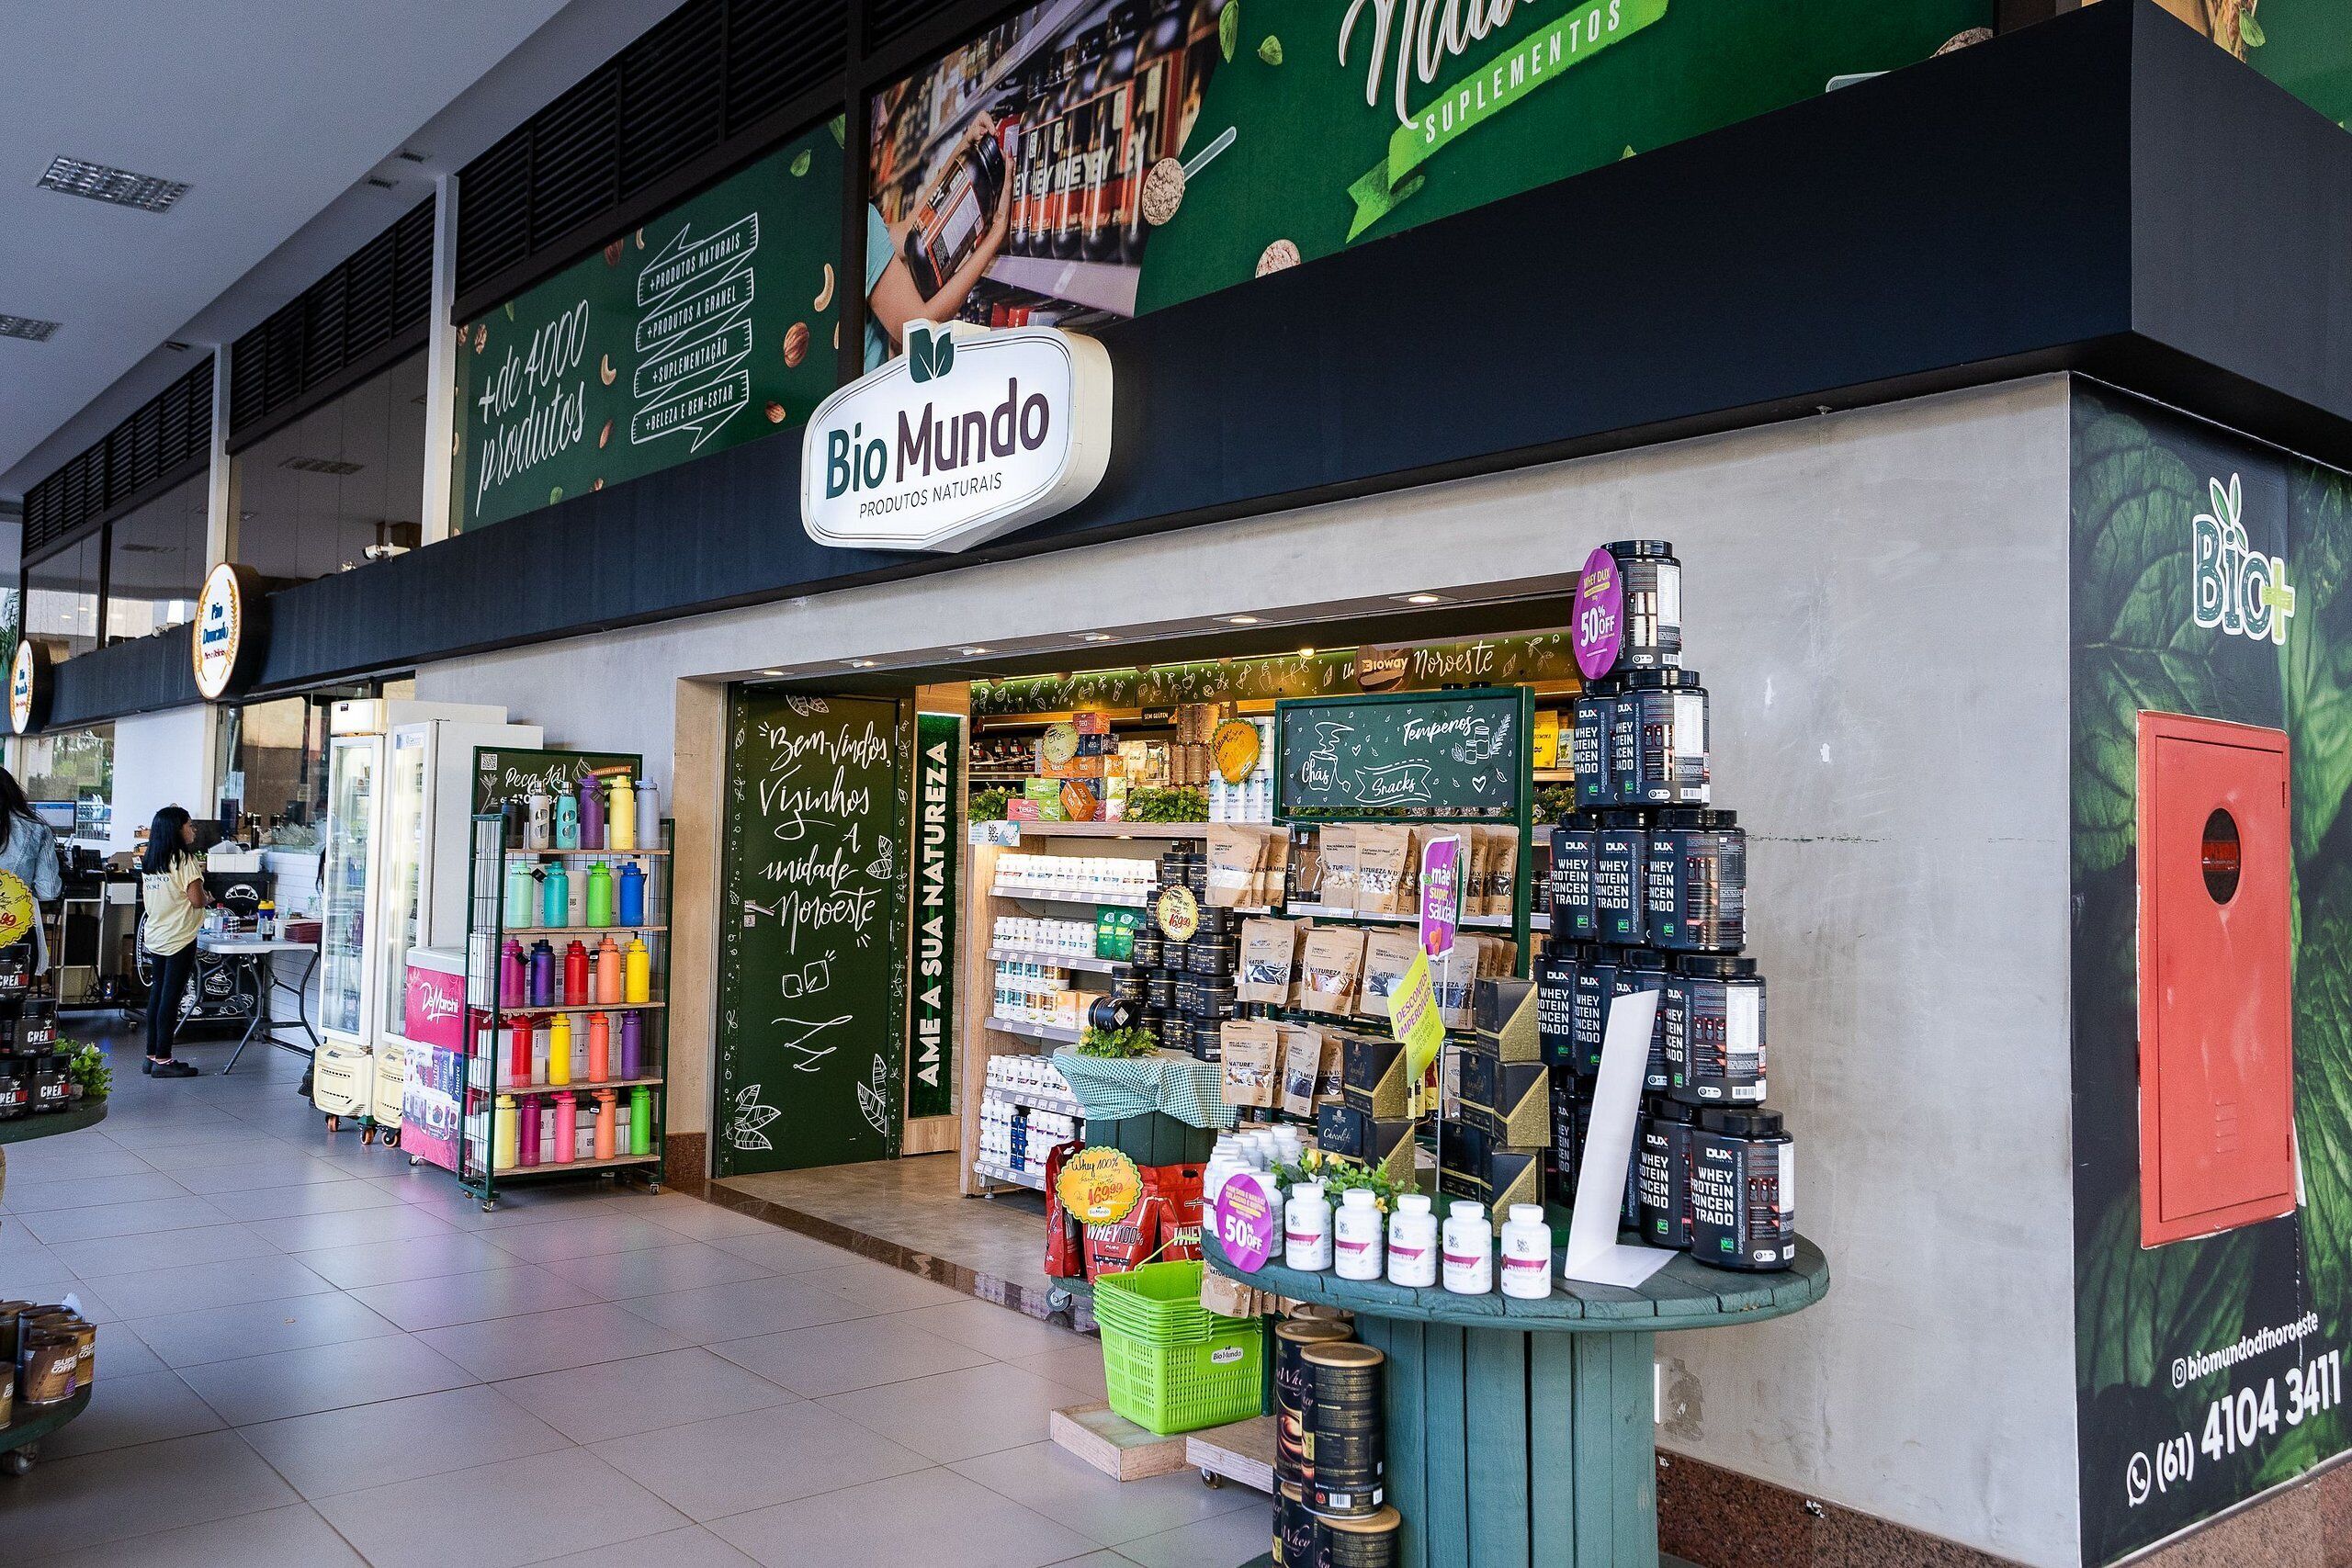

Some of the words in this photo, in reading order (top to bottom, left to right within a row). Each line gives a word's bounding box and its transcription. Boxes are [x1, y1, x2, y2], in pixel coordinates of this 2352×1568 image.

[1425, 0, 1621, 143] SUPLEMENTOS
[698, 231, 741, 273] NATURAIS
[695, 304, 703, 319] A
[705, 287, 737, 316] GRANEL
[525, 299, 589, 395] 4000
[680, 406, 686, 420] E
[687, 386, 734, 418] BEM-ESTAR
[477, 380, 587, 516] produtos
[826, 422, 888, 501] Bio
[896, 377, 1050, 483] Mundo
[860, 491, 928, 519] PRODUTOS
[933, 472, 1002, 503] NATURAIS
[1599, 615, 1615, 635] OFF
[1414, 640, 1495, 680] Noroeste
[1578, 709, 1598, 718] DUX
[1617, 704, 1633, 712] DUX
[1403, 715, 1486, 746] Temperos
[1372, 770, 1416, 797] Snacks
[760, 764, 869, 840] Vizinhos
[922, 741, 948, 906] NATUREZA
[842, 822, 862, 853] A
[1566, 841, 1588, 851] DUX
[1605, 842, 1628, 851] DUX
[1654, 842, 1674, 851] DUX
[759, 844, 859, 889] unidade
[1558, 859, 1589, 870] WHEY
[1600, 861, 1629, 872] WHEY
[1551, 871, 1589, 882] PROTEIN
[1551, 883, 1589, 894] CONCEN
[1555, 895, 1589, 906] TRADO
[1598, 897, 1629, 909] TRADO
[922, 916, 944, 976] SUA
[1547, 971, 1568, 980] DUX
[1580, 976, 1599, 987] DUX
[920, 985, 941, 1010] A
[1540, 987, 1569, 1000] WHEY
[1616, 983, 1632, 993] DUX
[1668, 988, 1683, 1000] DUX
[917, 1018, 941, 1087] AME
[1646, 1134, 1668, 1146] DUX
[1641, 1152, 1669, 1168] WHEY
[1706, 1147, 1733, 1160] DUX
[1698, 1167, 1734, 1184] WHEY
[1691, 1192, 1734, 1213] CONCEN
[1695, 1207, 1734, 1226] TRADO
[1247, 1232, 1263, 1250] OFF
[2156, 1431, 2194, 1493] (61)
[2201, 1378, 2278, 1461] 4104
[2285, 1349, 2341, 1426] 3411
